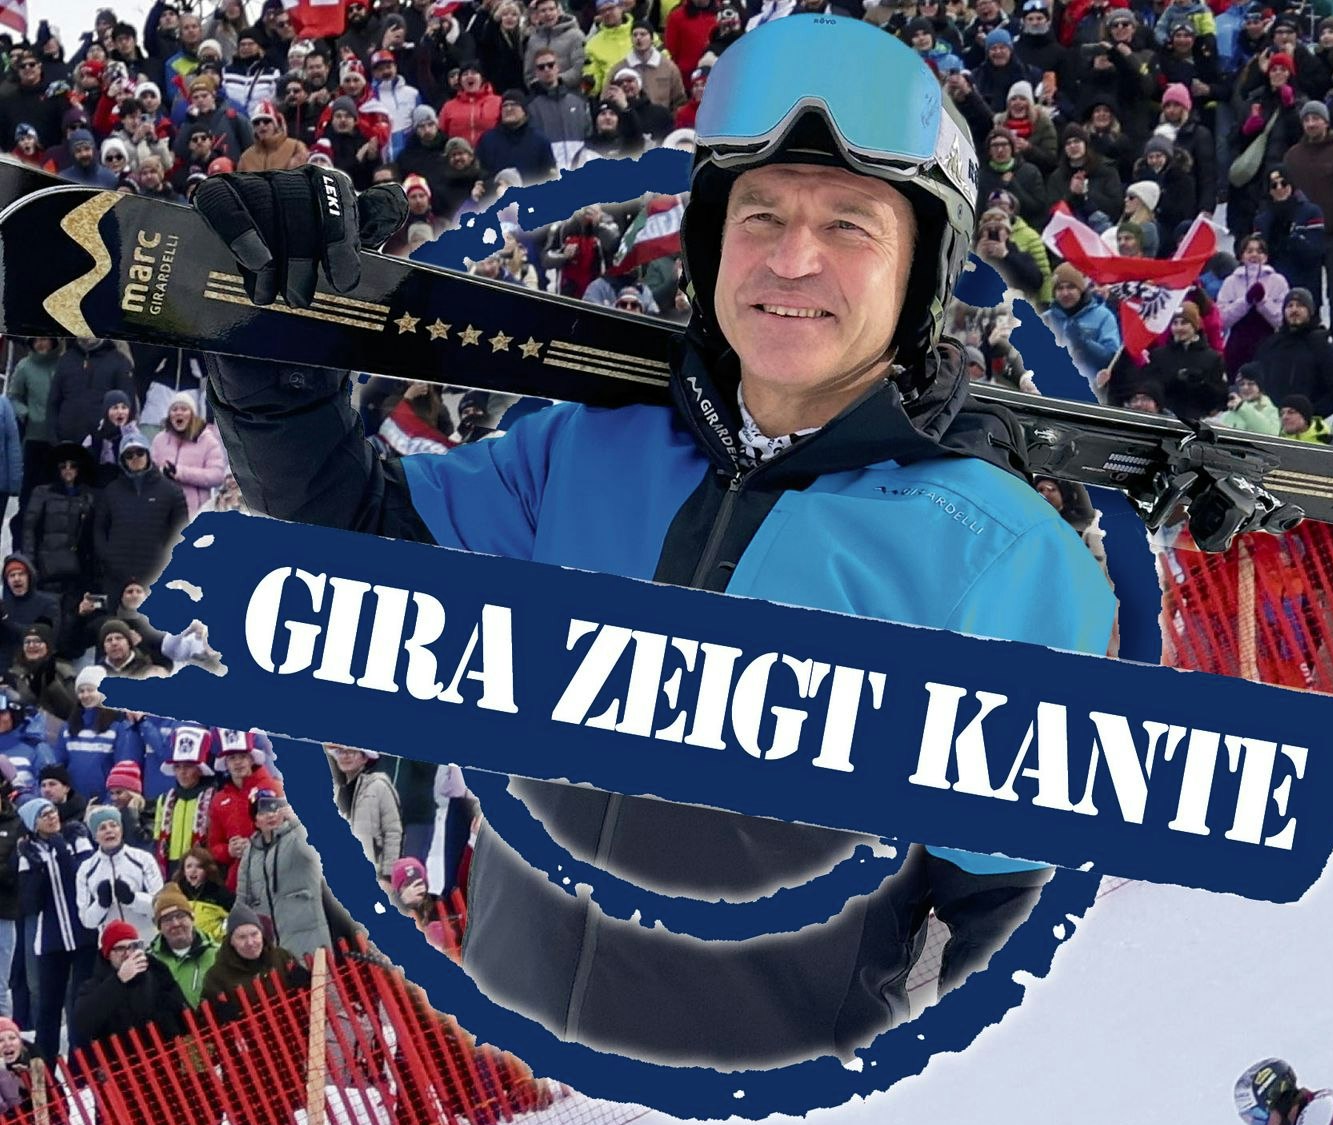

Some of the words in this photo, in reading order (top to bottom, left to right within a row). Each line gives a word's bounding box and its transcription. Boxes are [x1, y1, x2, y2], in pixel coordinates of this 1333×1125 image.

[322, 175, 341, 217] LEKI
[121, 229, 161, 313] marc
[150, 235, 179, 316] GIRARDELLI
